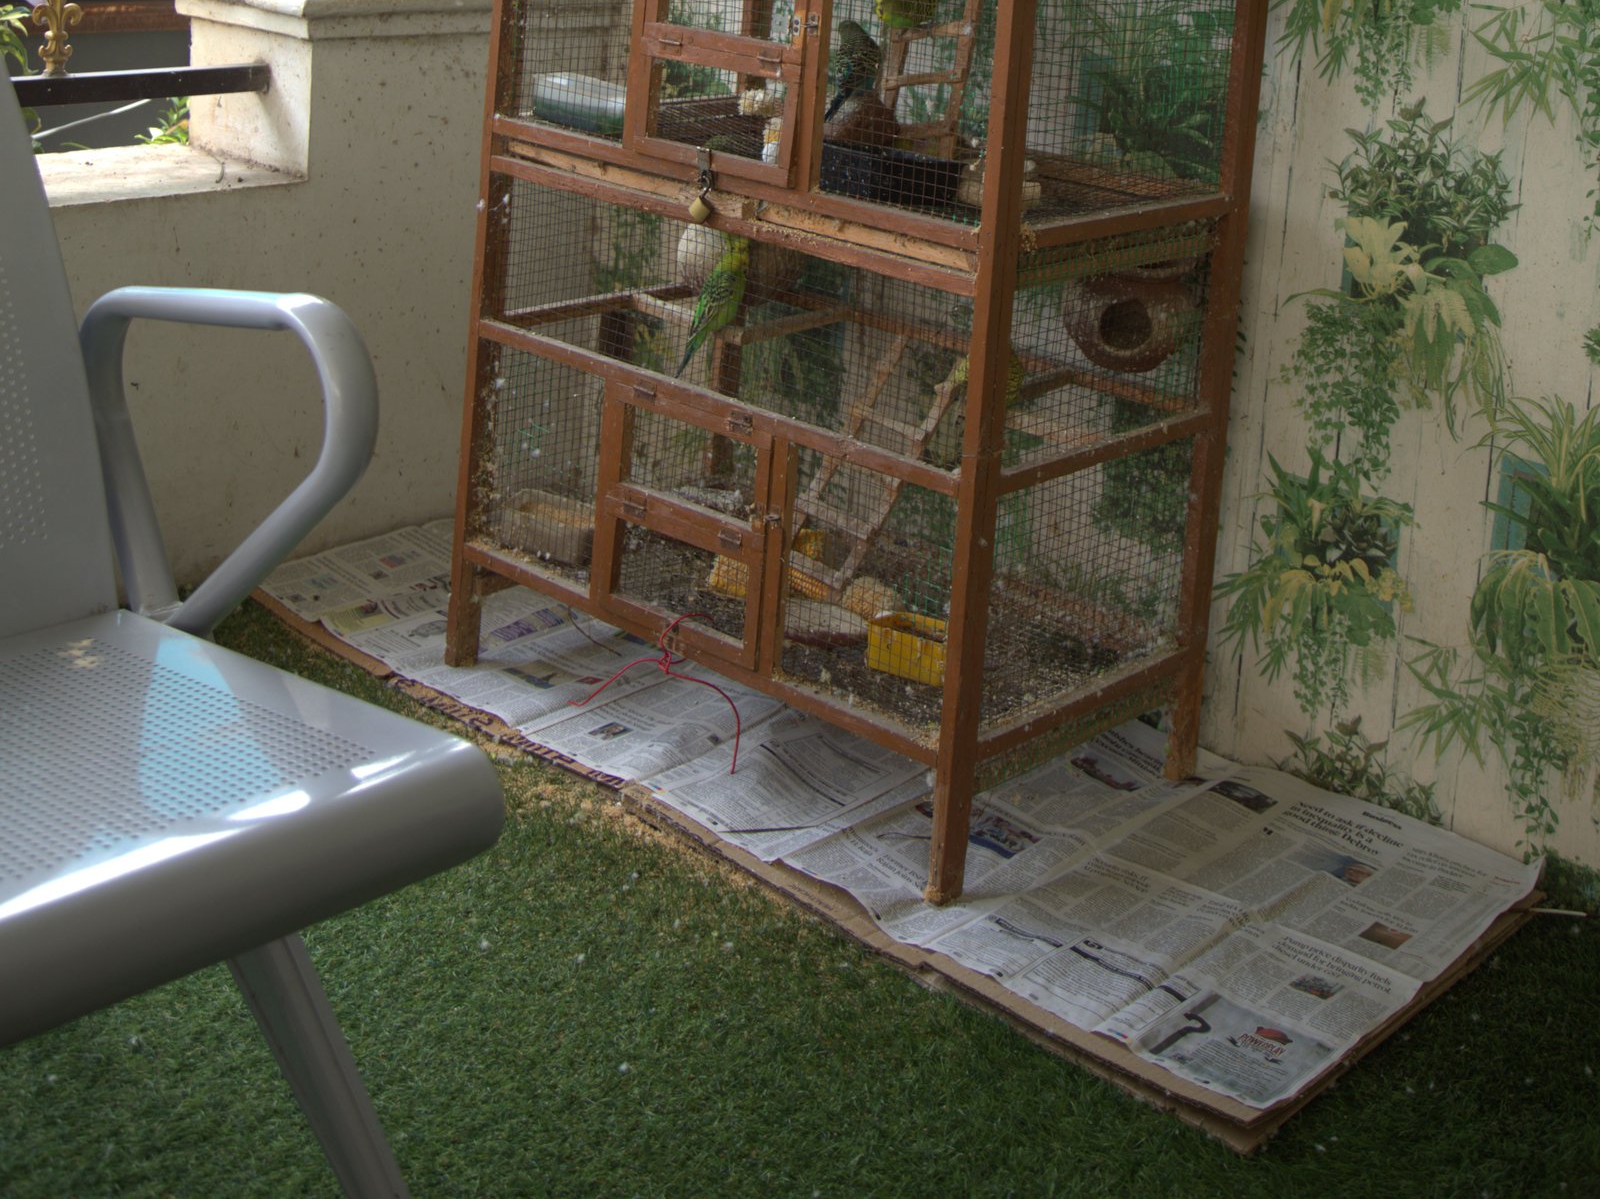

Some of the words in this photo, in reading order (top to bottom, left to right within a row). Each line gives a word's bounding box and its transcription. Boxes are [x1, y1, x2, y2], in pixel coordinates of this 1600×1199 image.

[1281, 810, 1311, 824] good
[1342, 833, 1379, 855] Debroy
[1303, 809, 1353, 833] inequality
[1364, 827, 1404, 848] decline
[1272, 945, 1297, 961] diesel
[1296, 958, 1321, 972] under
[1278, 941, 1313, 958] demand
[1308, 946, 1332, 959] price
[1331, 956, 1368, 976] disparity
[1370, 973, 1391, 986] fuels
